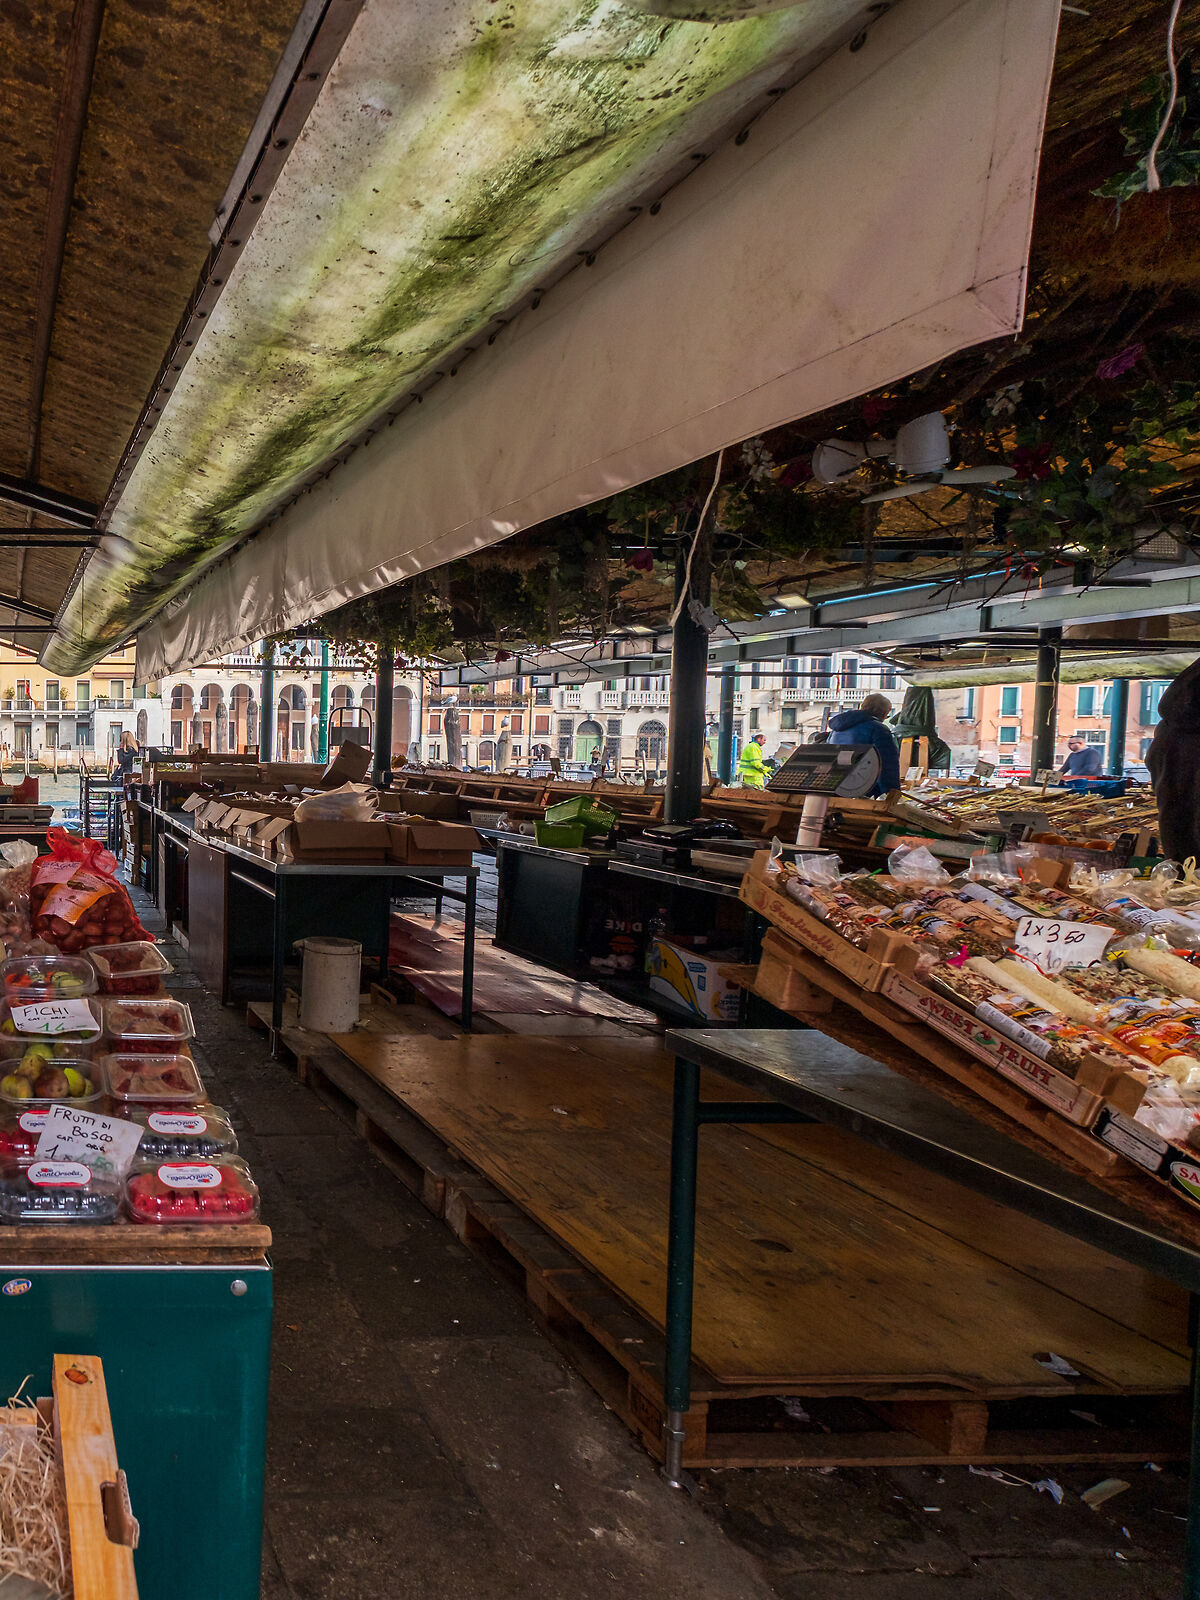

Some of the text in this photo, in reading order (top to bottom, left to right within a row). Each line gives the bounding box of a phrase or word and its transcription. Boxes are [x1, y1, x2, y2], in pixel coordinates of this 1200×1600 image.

[23, 1006, 69, 1017] FICHI
[919, 997, 978, 1035] SWEET
[997, 1041, 1056, 1086] FRUIT
[53, 1107, 96, 1126] FRUTTI
[101, 1122, 111, 1130] DI
[72, 1126, 113, 1143] BOSCO
